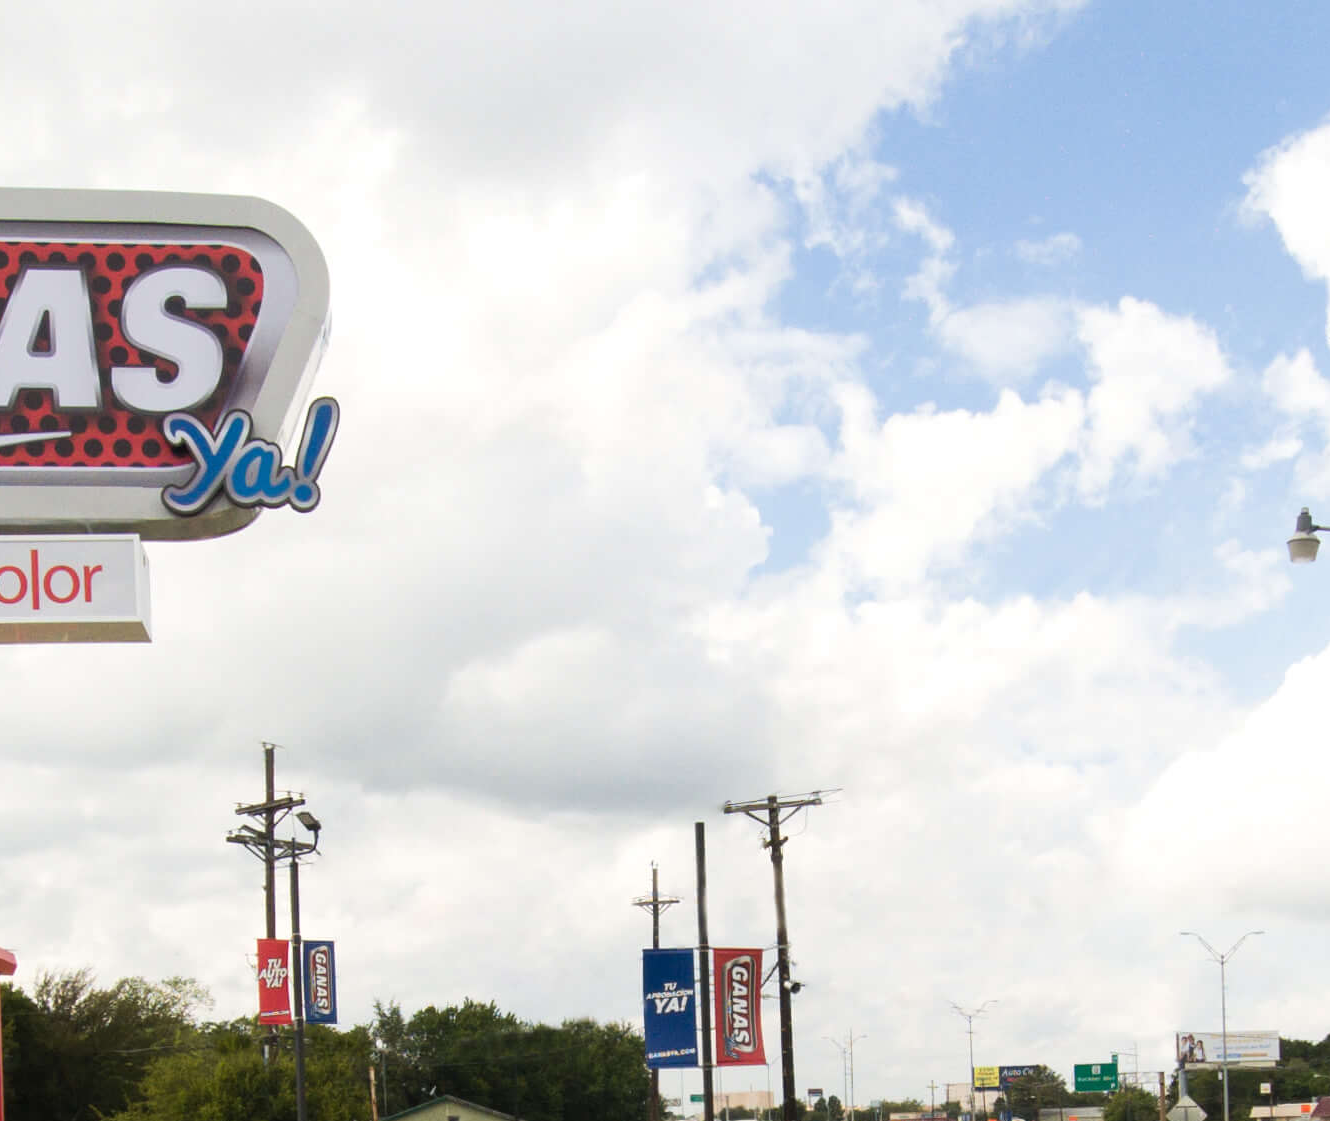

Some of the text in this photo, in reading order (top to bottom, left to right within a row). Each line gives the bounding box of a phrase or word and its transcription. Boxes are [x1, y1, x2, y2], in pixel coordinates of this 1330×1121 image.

[162, 398, 340, 514] Ya!
[268, 958, 282, 968] TU
[259, 967, 287, 979] AUTO
[316, 953, 328, 1010] GANAS
[664, 982, 677, 991] TU
[654, 996, 688, 1014] YA!
[731, 965, 750, 1044] GANAS
